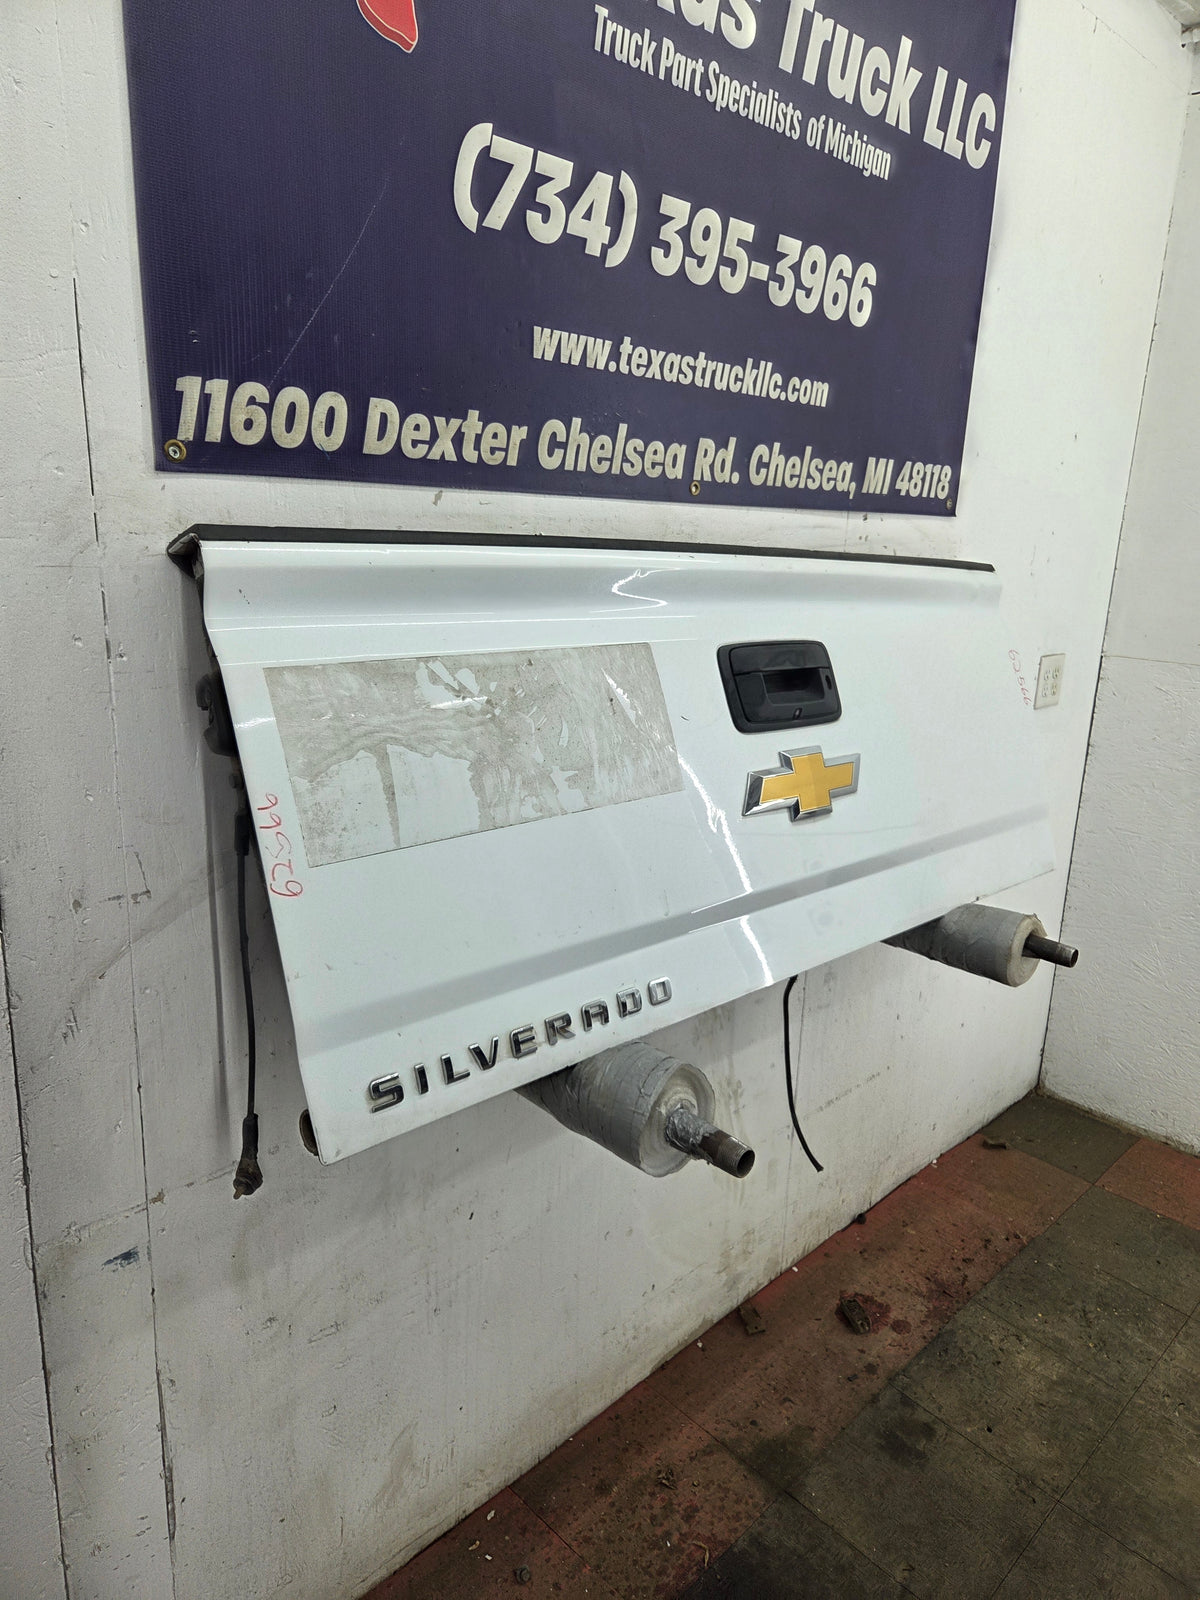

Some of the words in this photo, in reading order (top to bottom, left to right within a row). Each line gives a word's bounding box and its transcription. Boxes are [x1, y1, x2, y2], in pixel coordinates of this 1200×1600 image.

[593, 4, 655, 76] Truck
[658, 36, 704, 97] Part
[705, 60, 802, 140] Specialists
[806, 114, 826, 151] of
[823, 117, 892, 181] Michigan
[778, 0, 924, 135] Truck
[922, 65, 997, 170] LLC
[453, 122, 638, 268] (734)
[650, 193, 877, 328] 395-3966
[533, 325, 829, 408] www.texastruckllc.com
[175, 375, 348, 453] 11600
[362, 397, 528, 467] Dexter
[537, 416, 687, 480] Chelsea
[691, 436, 740, 486] Rd.
[748, 442, 857, 501] Chelsea,
[861, 456, 895, 496] MI
[893, 460, 952, 500] 48118
[257, 793, 303, 897] 62566
[369, 976, 672, 1113] SILVERADO
